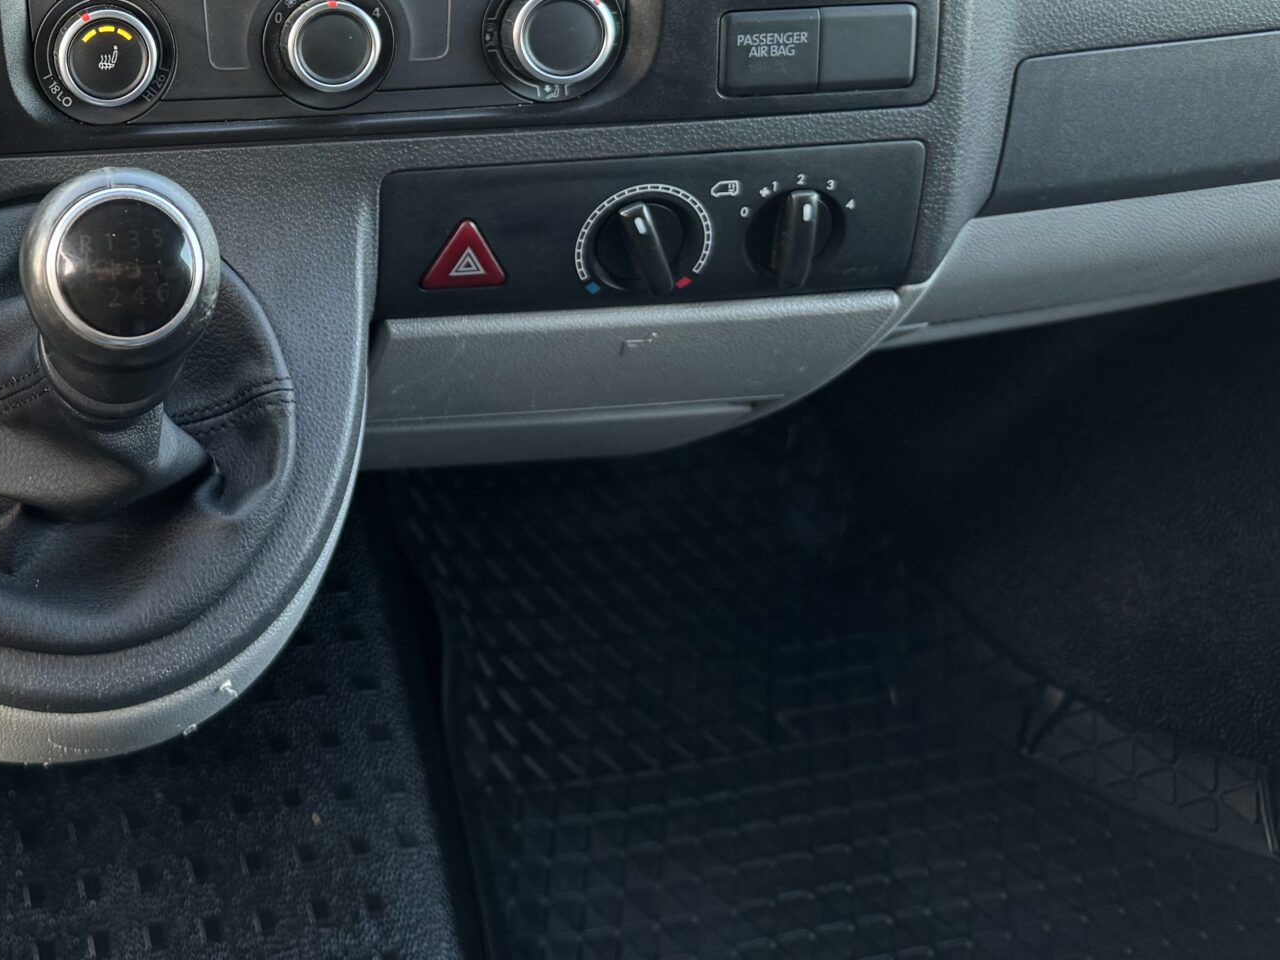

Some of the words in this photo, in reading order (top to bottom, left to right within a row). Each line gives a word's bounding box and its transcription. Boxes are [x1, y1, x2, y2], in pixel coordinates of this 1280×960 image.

[274, 11, 283, 24] 0
[372, 7, 382, 19] 4
[736, 31, 808, 46] PASSENGER
[748, 45, 768, 58] AIR
[770, 44, 795, 57] BAG
[796, 173, 806, 185] 2
[826, 179, 835, 190] 3
[771, 181, 778, 192] 1
[844, 199, 856, 210] 4
[740, 206, 749, 218] 0
